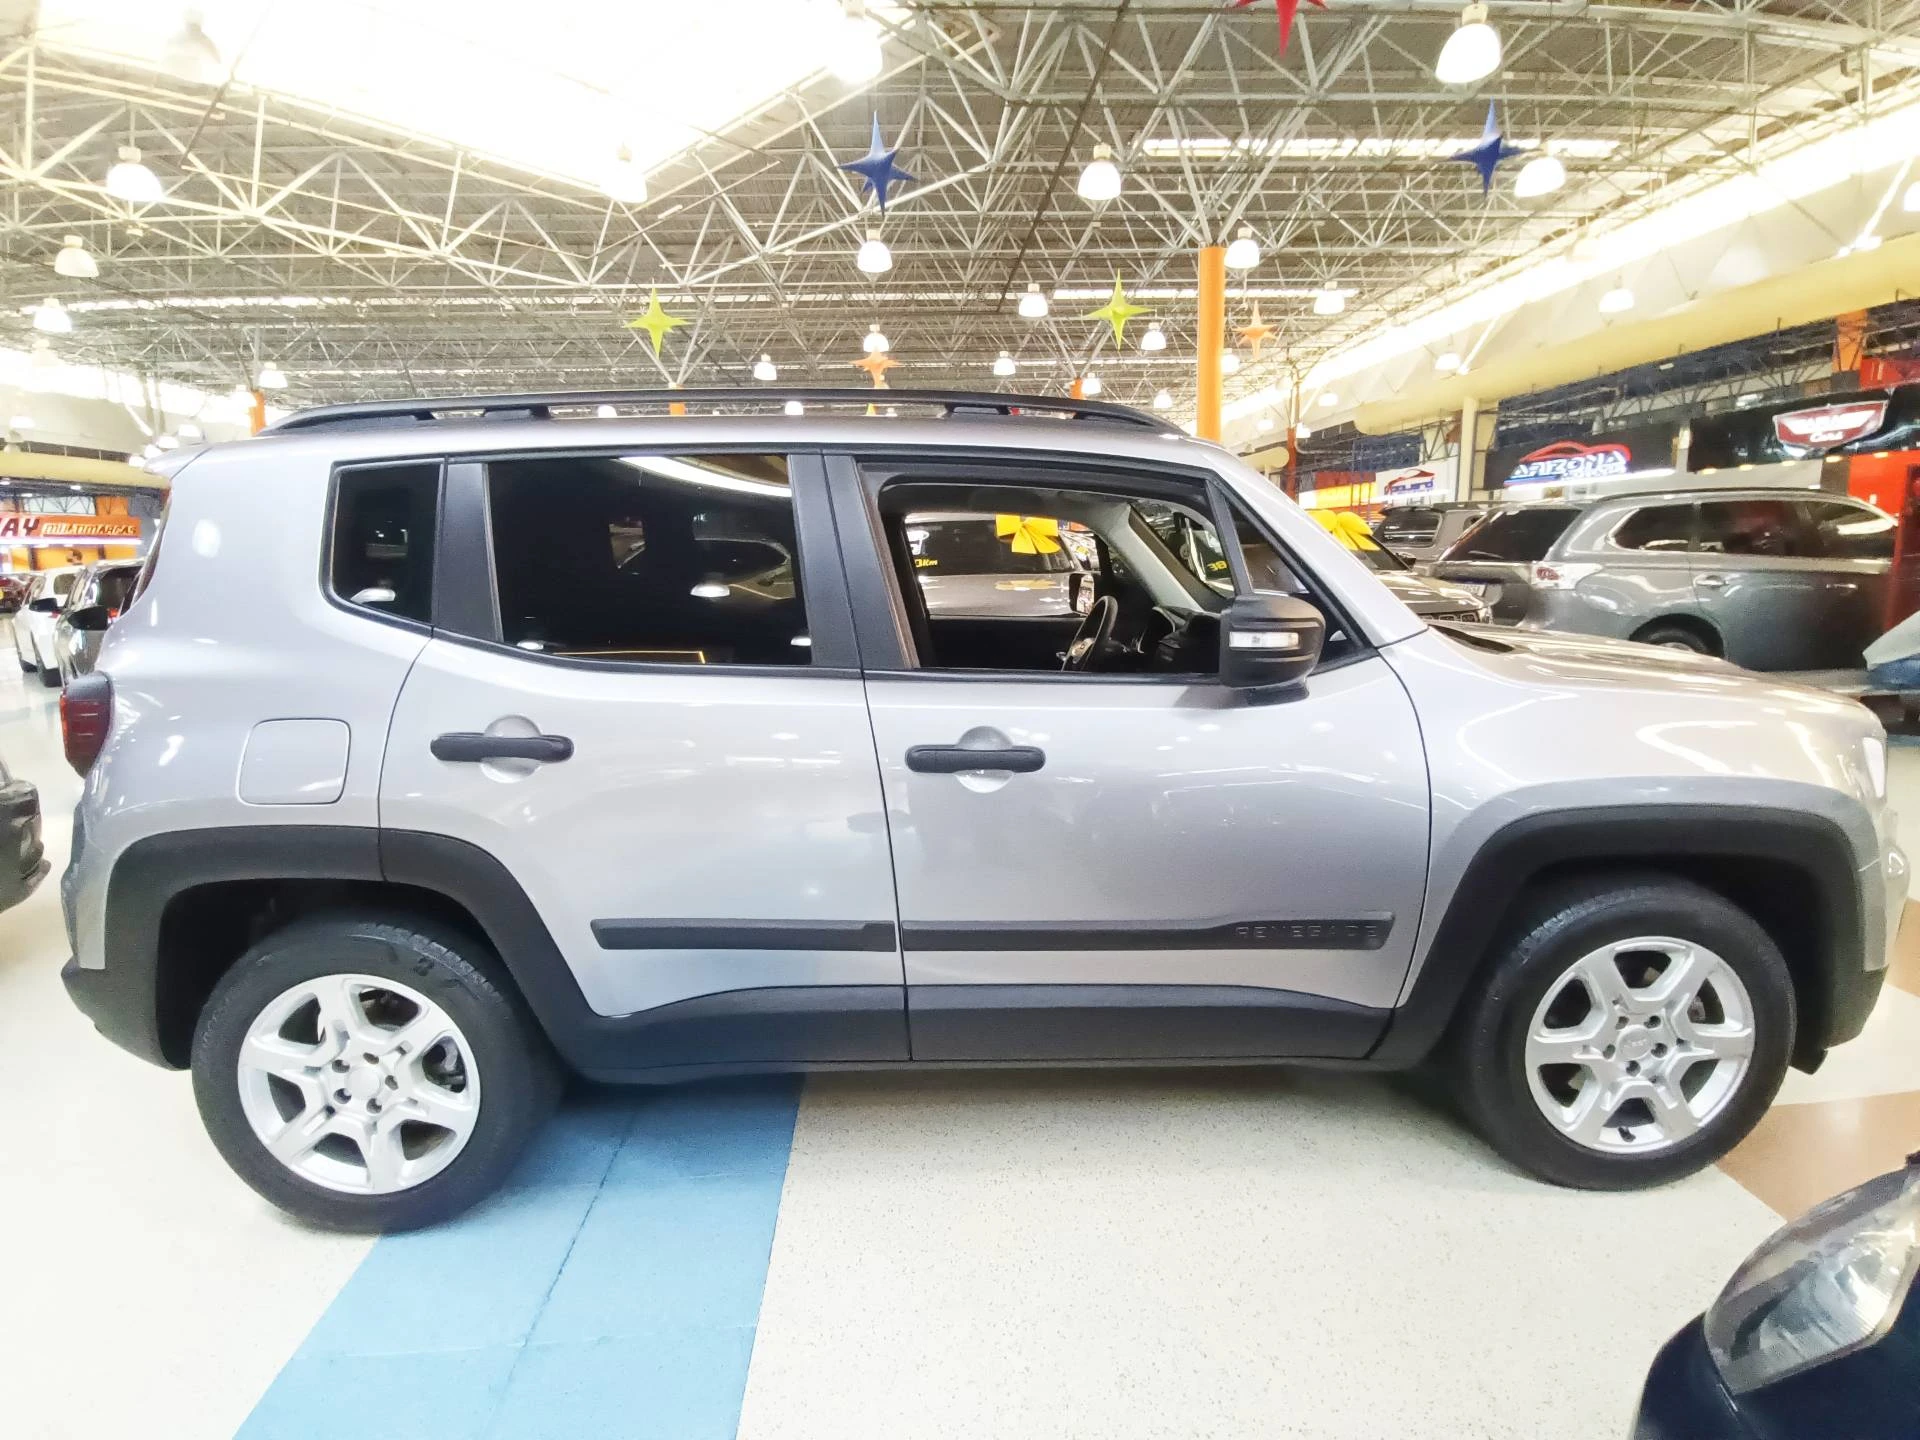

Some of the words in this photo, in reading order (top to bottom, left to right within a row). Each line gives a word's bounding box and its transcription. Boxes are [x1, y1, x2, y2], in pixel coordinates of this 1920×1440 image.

[1510, 450, 1626, 480] ARIZONA
[0, 517, 40, 537] AY
[1234, 925, 1378, 939] RENEGADE
